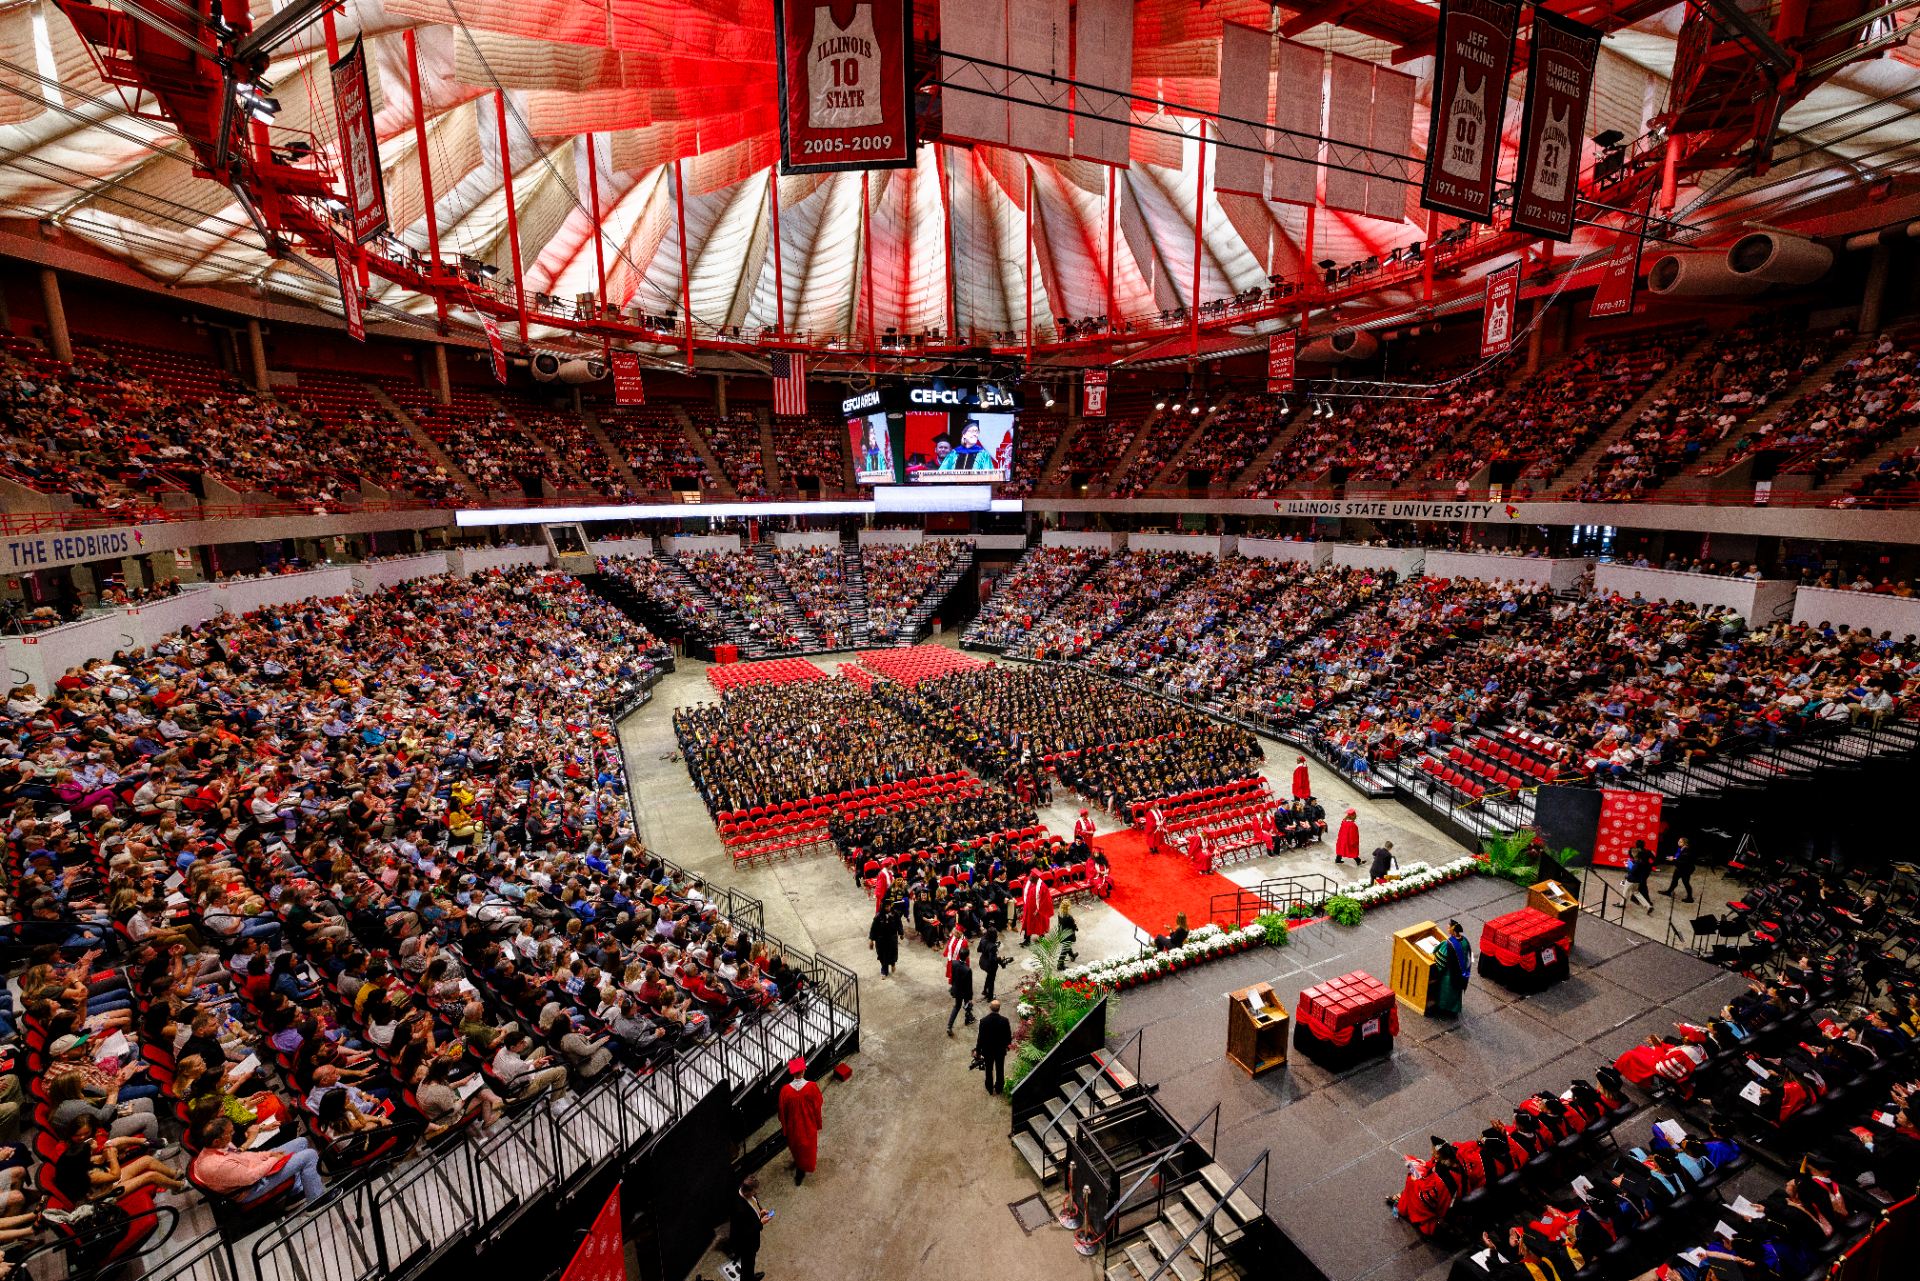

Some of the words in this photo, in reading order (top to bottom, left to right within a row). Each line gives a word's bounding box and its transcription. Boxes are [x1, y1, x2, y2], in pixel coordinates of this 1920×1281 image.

[817, 36, 872, 62] ILLINOIS
[1467, 30, 1488, 48] JEFF
[1456, 41, 1495, 68] WILKINS
[830, 57, 859, 87] 10
[1547, 60, 1580, 84] BUBBLES
[1545, 73, 1580, 99] HAWKINS
[826, 89, 864, 109] STATE
[1456, 117, 1477, 145] 00
[804, 136, 892, 154] 2005-2009
[1453, 145, 1474, 164] STATE
[1544, 144, 1559, 169] 21
[1540, 169, 1558, 187] STATE
[1491, 288, 1511, 299] COLLINS
[1493, 318, 1503, 329] 20
[842, 394, 860, 412] CEFCU
[860, 391, 880, 408] ARENA
[1288, 503, 1341, 514] ILLINOIS
[1346, 503, 1386, 515] STATE
[1393, 504, 1493, 518] UNIVERSITY
[9, 541, 47, 566] THE
[53, 532, 128, 561] REDBIRDS
